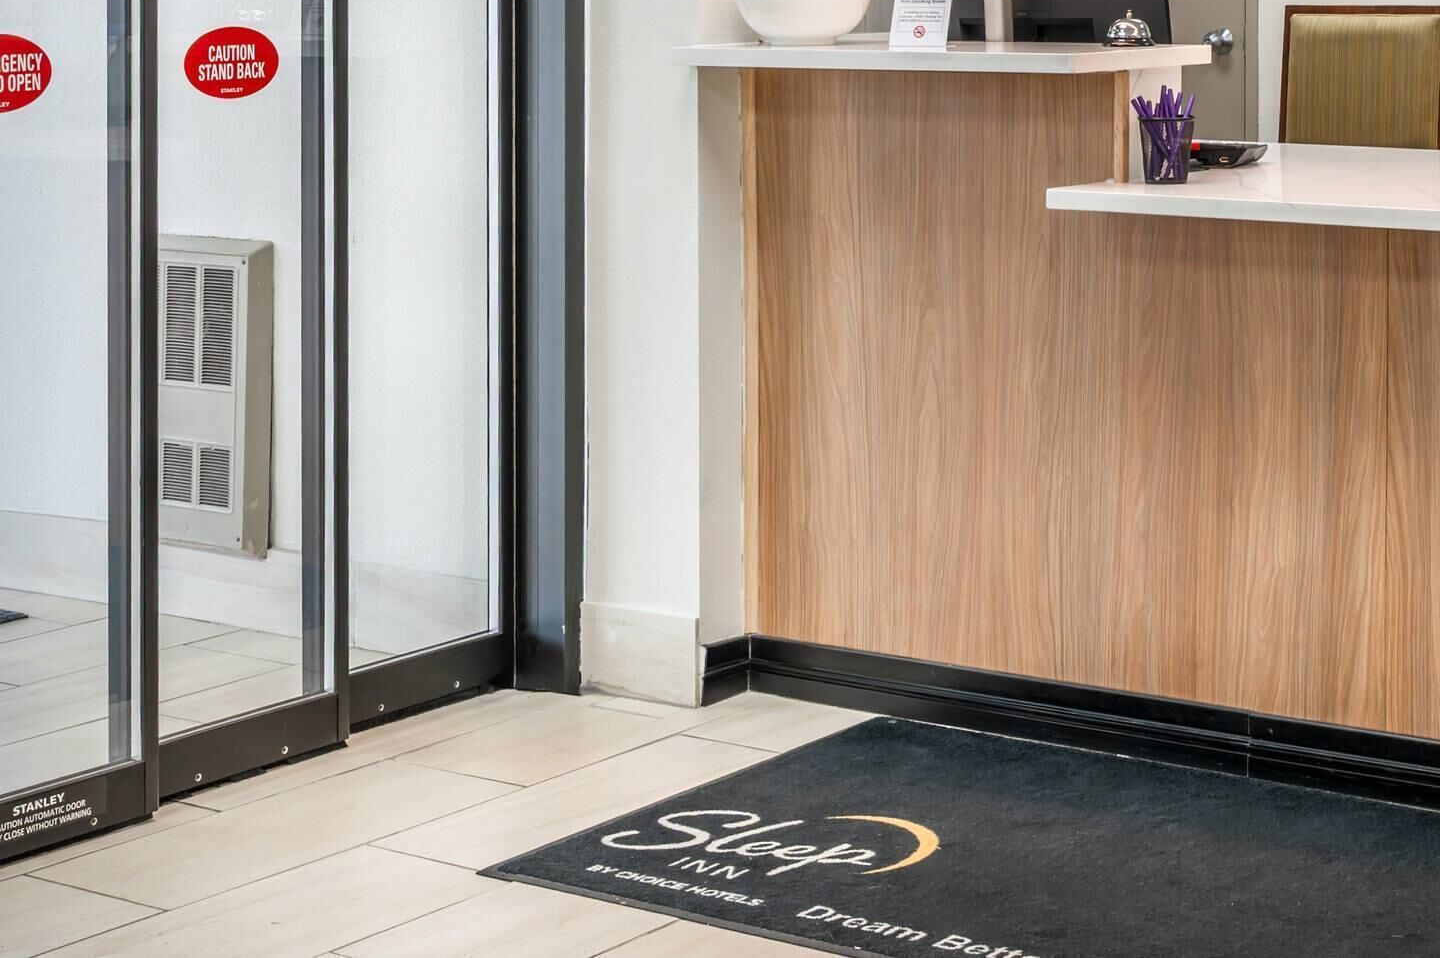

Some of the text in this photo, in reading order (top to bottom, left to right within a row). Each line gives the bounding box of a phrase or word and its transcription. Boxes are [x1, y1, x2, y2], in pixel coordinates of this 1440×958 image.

[0, 53, 43, 73] GENCY
[208, 43, 256, 63] CAUTION
[7, 72, 42, 93] OPEN
[198, 61, 266, 82] STAND BACK
[12, 792, 65, 817] STANLEY
[24, 805, 65, 824] AUTOMATIC
[66, 799, 87, 812] DOOR
[3, 827, 25, 841] CLOSE
[25, 817, 59, 835] WITHOUT
[59, 807, 92, 824] WARNING
[600, 809, 873, 876] Sleep
[667, 856, 751, 880] INN
[585, 864, 766, 907] BY CHOICE HOTELS
[795, 904, 928, 943] Dream
